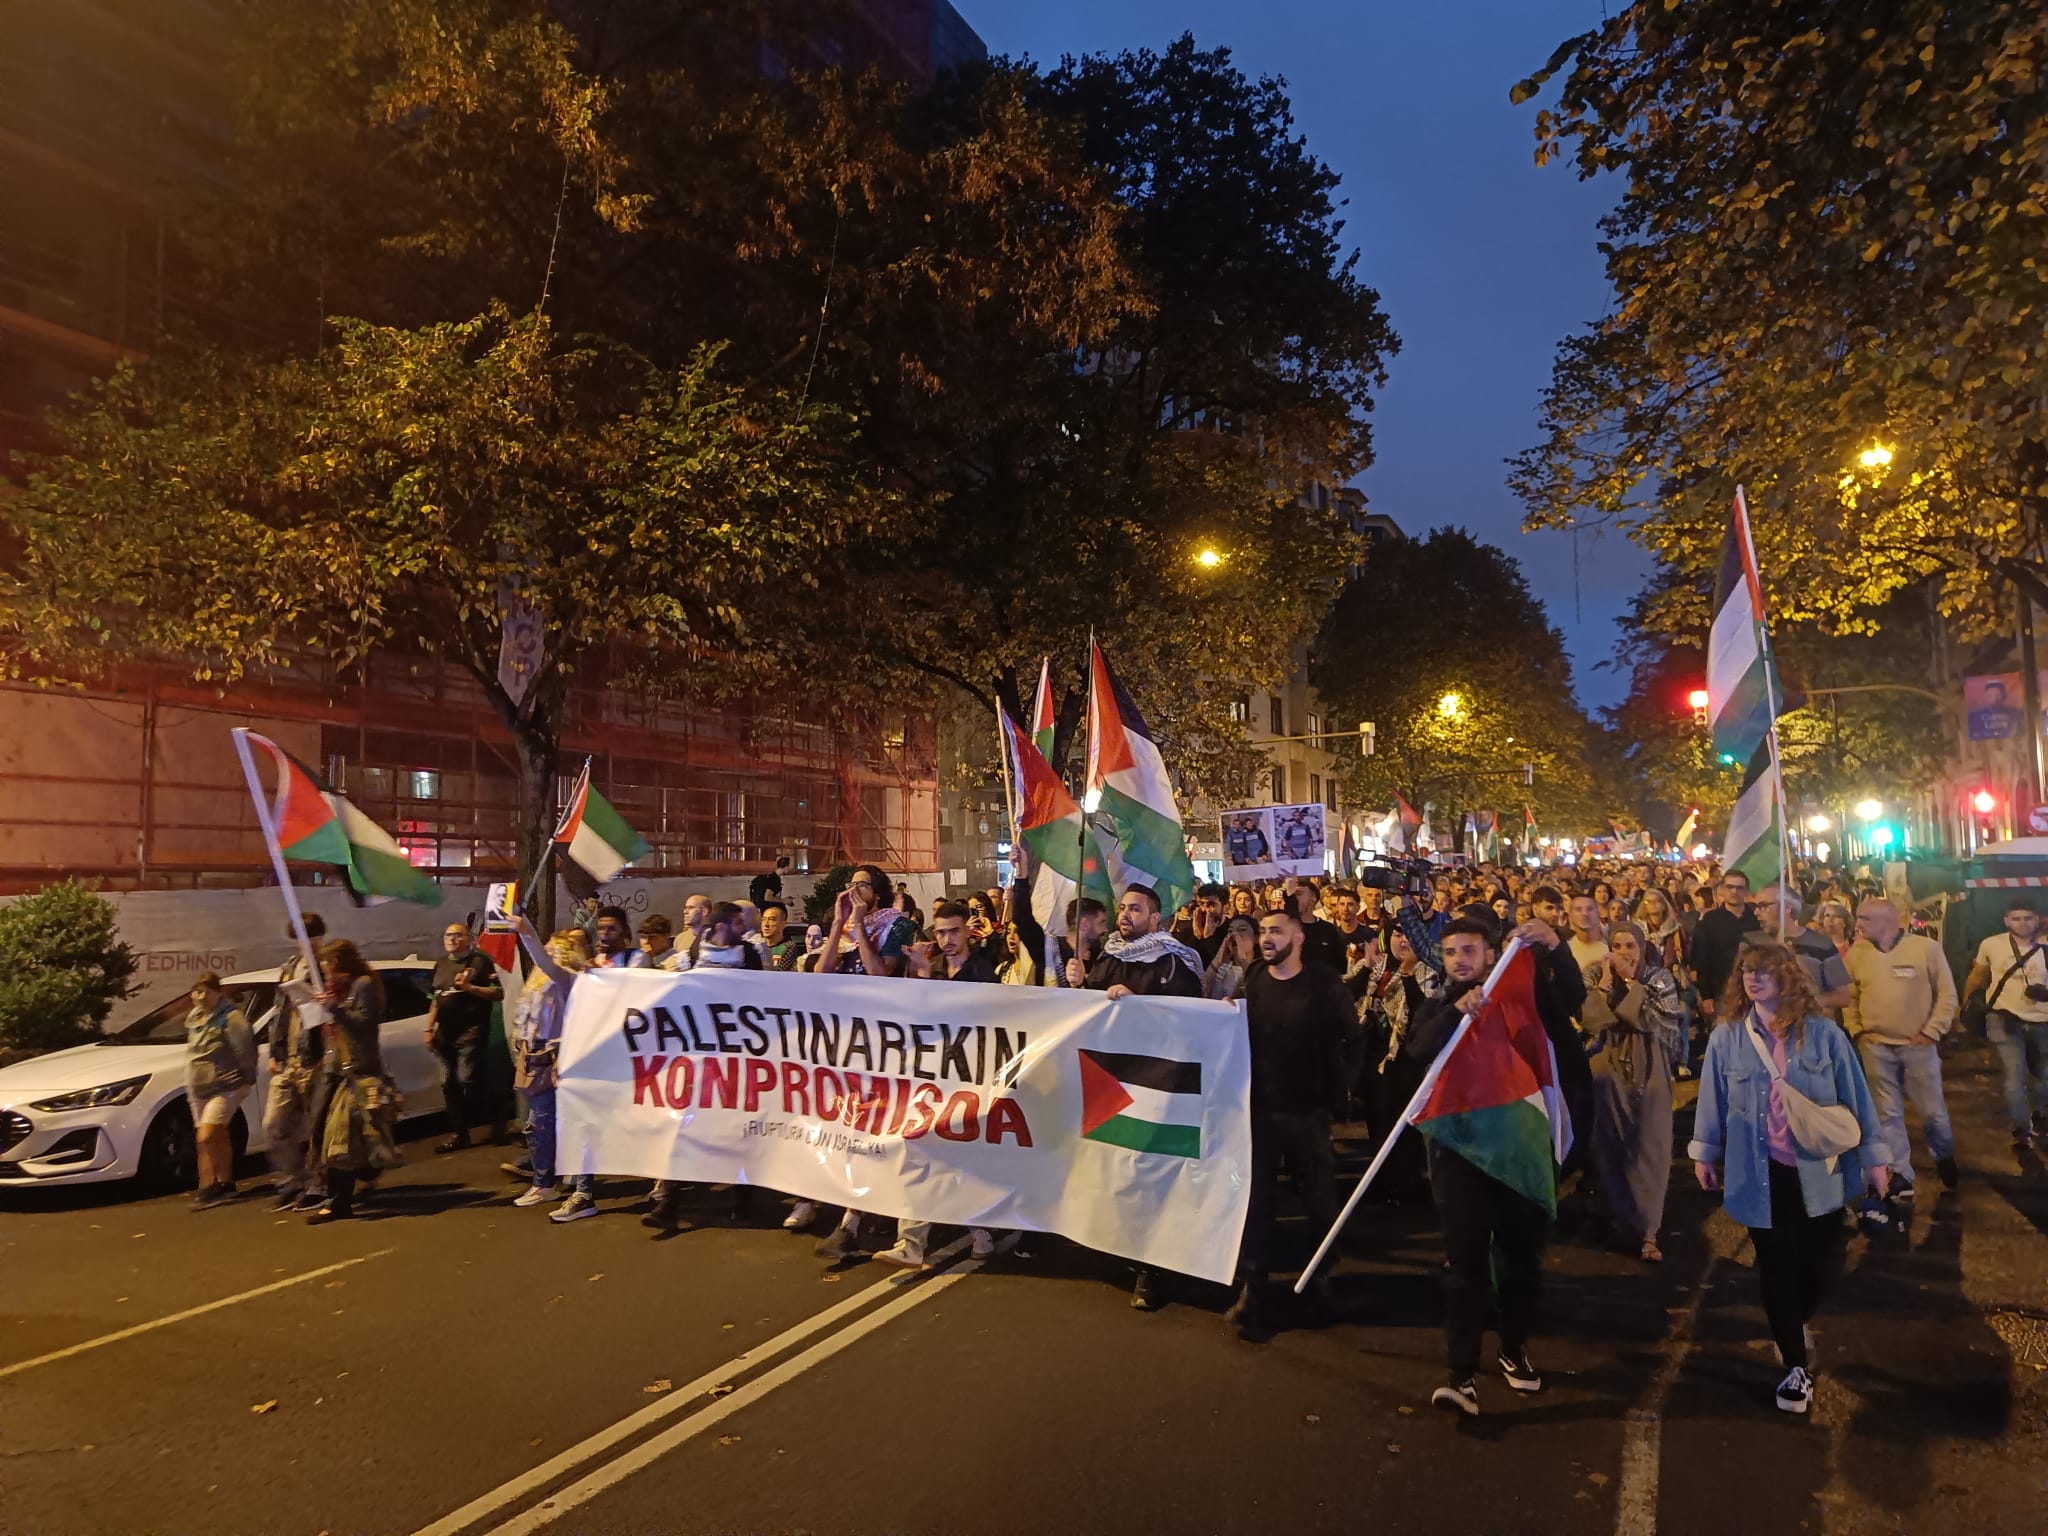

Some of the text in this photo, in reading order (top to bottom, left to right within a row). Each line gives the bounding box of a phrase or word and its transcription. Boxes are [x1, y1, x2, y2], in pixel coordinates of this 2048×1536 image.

[146, 951, 237, 972] EDHINOR
[623, 1003, 1027, 1089] PALESTINAREKIN
[630, 1055, 1033, 1147] KONPROMISOA
